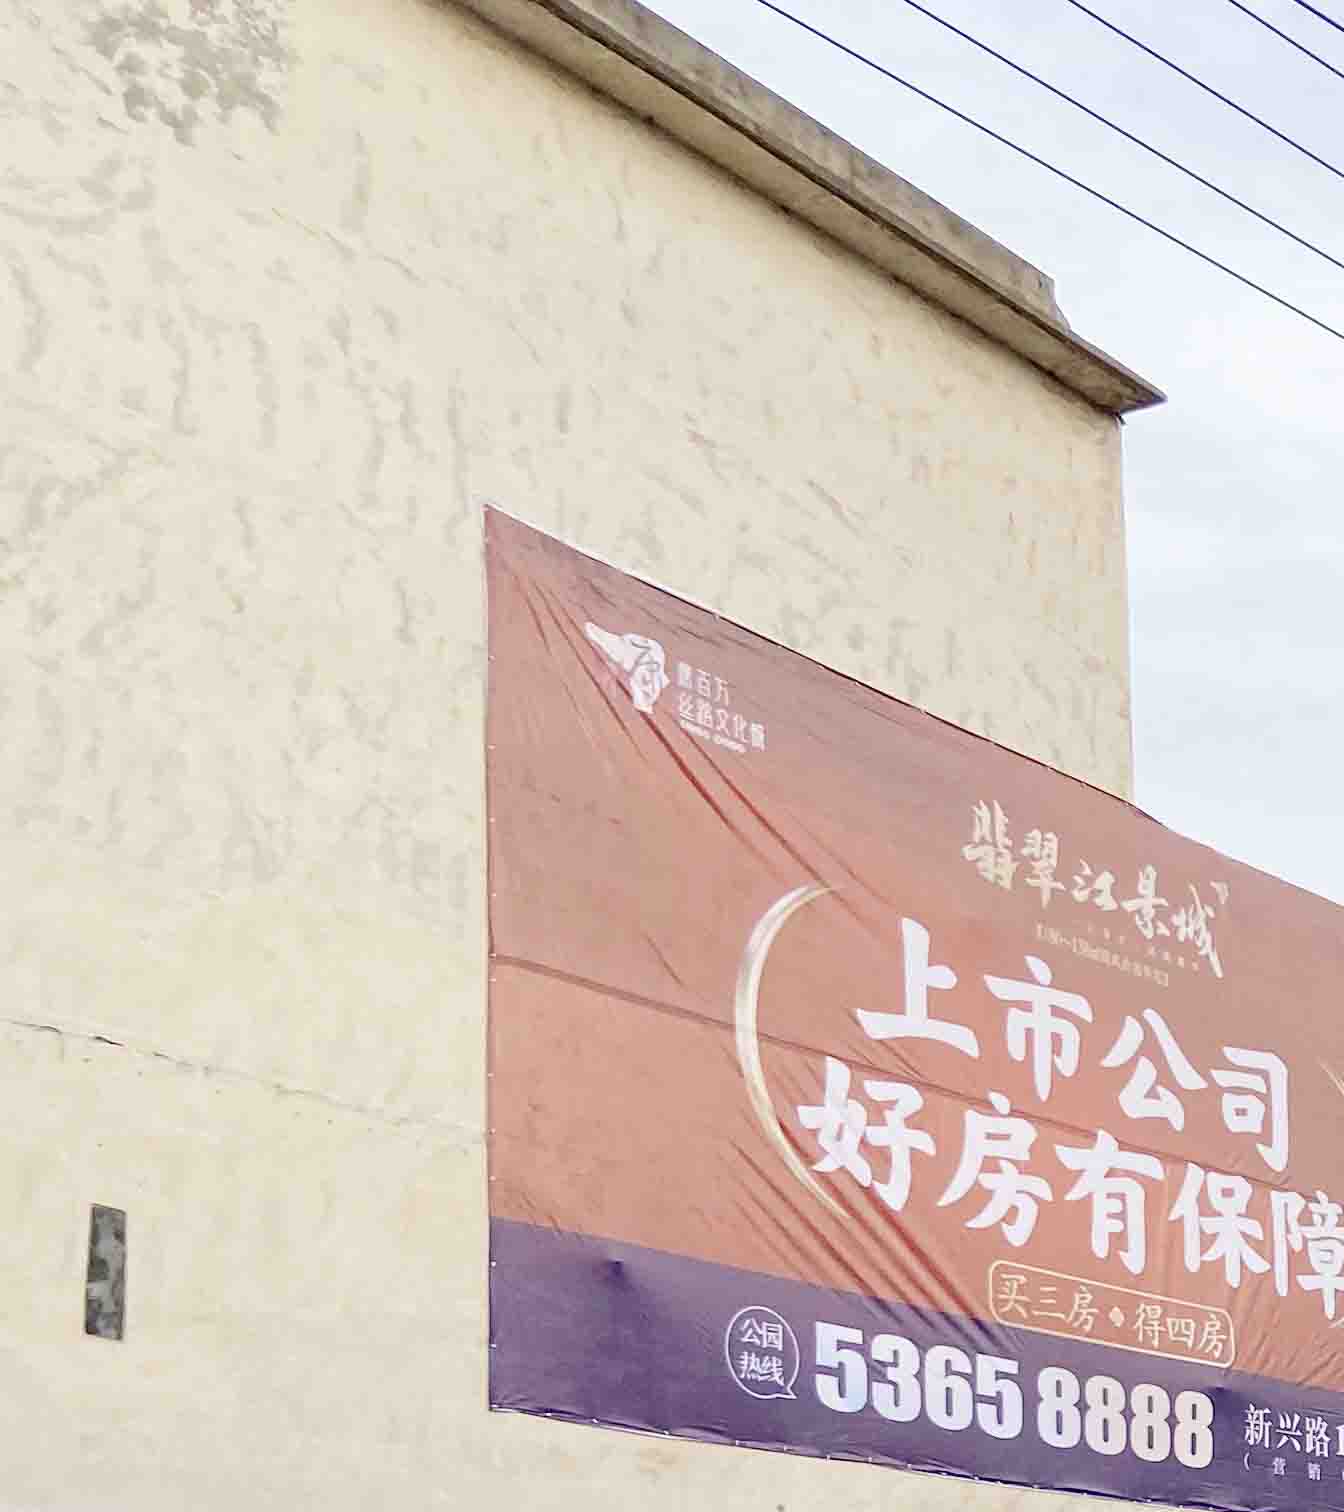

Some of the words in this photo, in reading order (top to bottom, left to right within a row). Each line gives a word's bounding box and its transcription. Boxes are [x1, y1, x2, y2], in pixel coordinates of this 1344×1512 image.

[962, 799, 1223, 978] 翡翠江景城
[855, 917, 1289, 1172] 上市公司
[739, 1351, 785, 1387] 热线
[740, 1317, 784, 1351] 公园
[815, 1320, 1024, 1440] 5365
[1036, 1366, 1215, 1469] 8888
